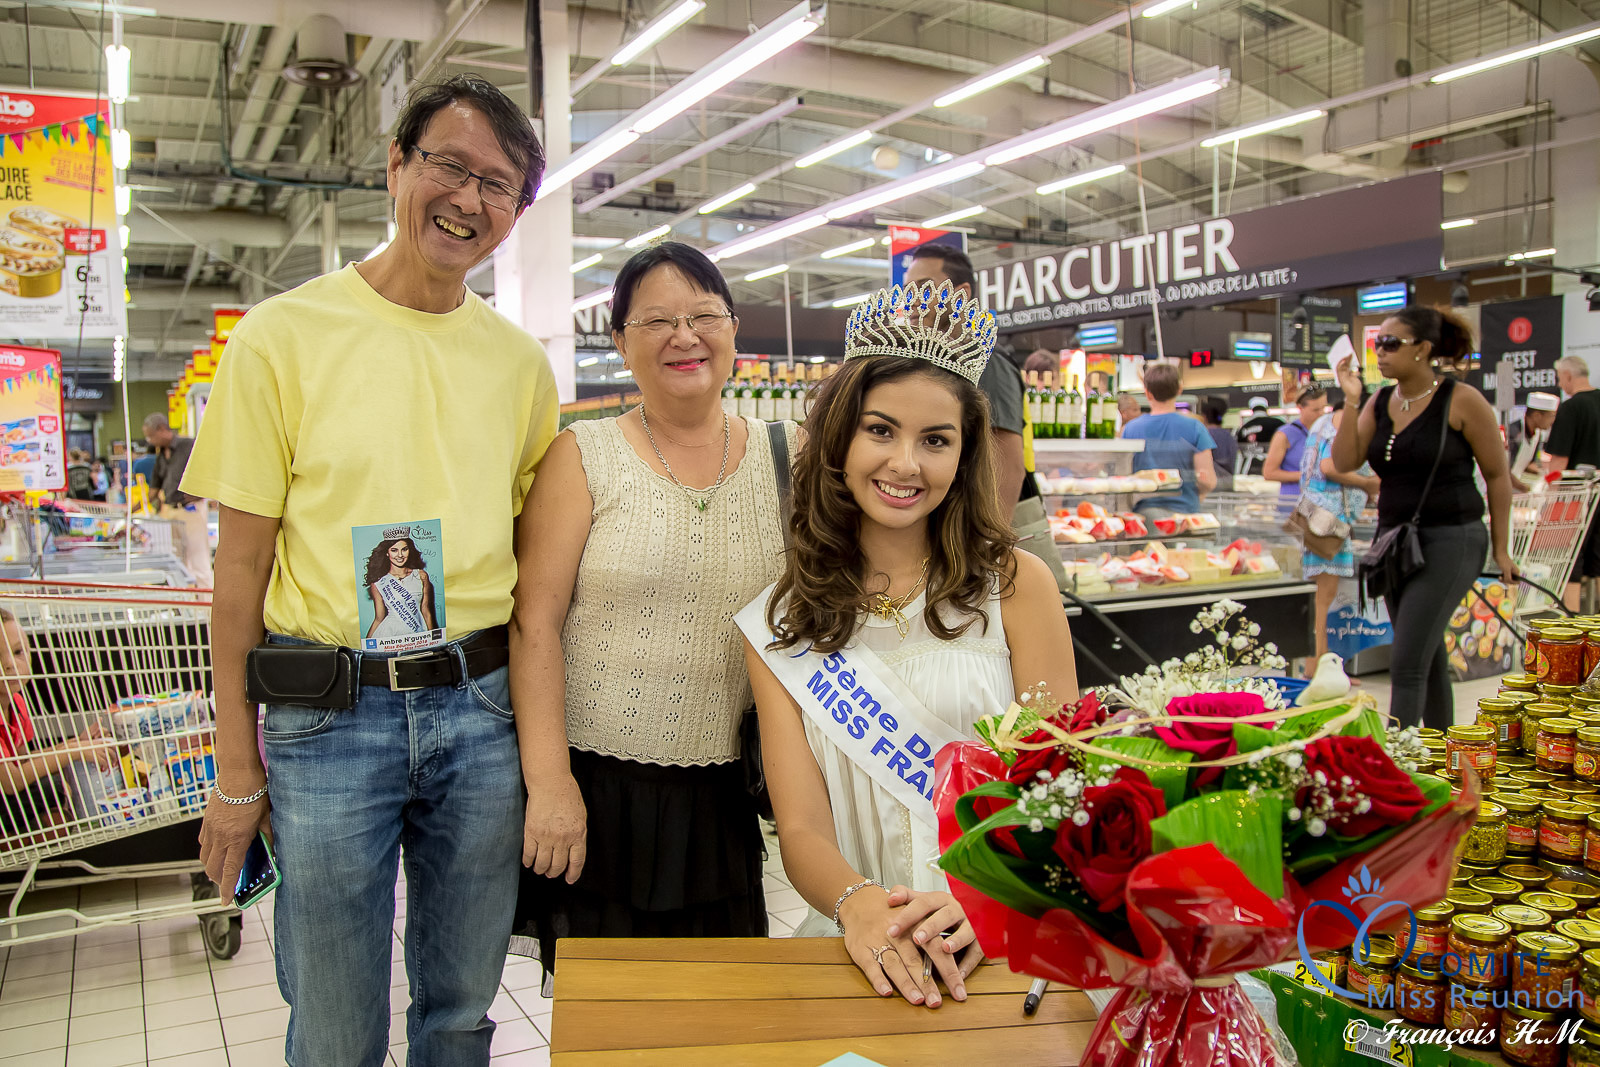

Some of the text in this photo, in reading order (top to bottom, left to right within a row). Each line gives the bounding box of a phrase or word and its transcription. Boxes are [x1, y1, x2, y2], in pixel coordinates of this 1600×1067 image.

[974, 219, 1239, 313] HARCUTIER
[1226, 275, 1242, 293] DE
[1242, 272, 1259, 290] LA
[1523, 369, 1557, 388] CHER
[380, 638, 402, 646] Ambre
[806, 669, 870, 740] MISS
[822, 651, 899, 733] 5ème
